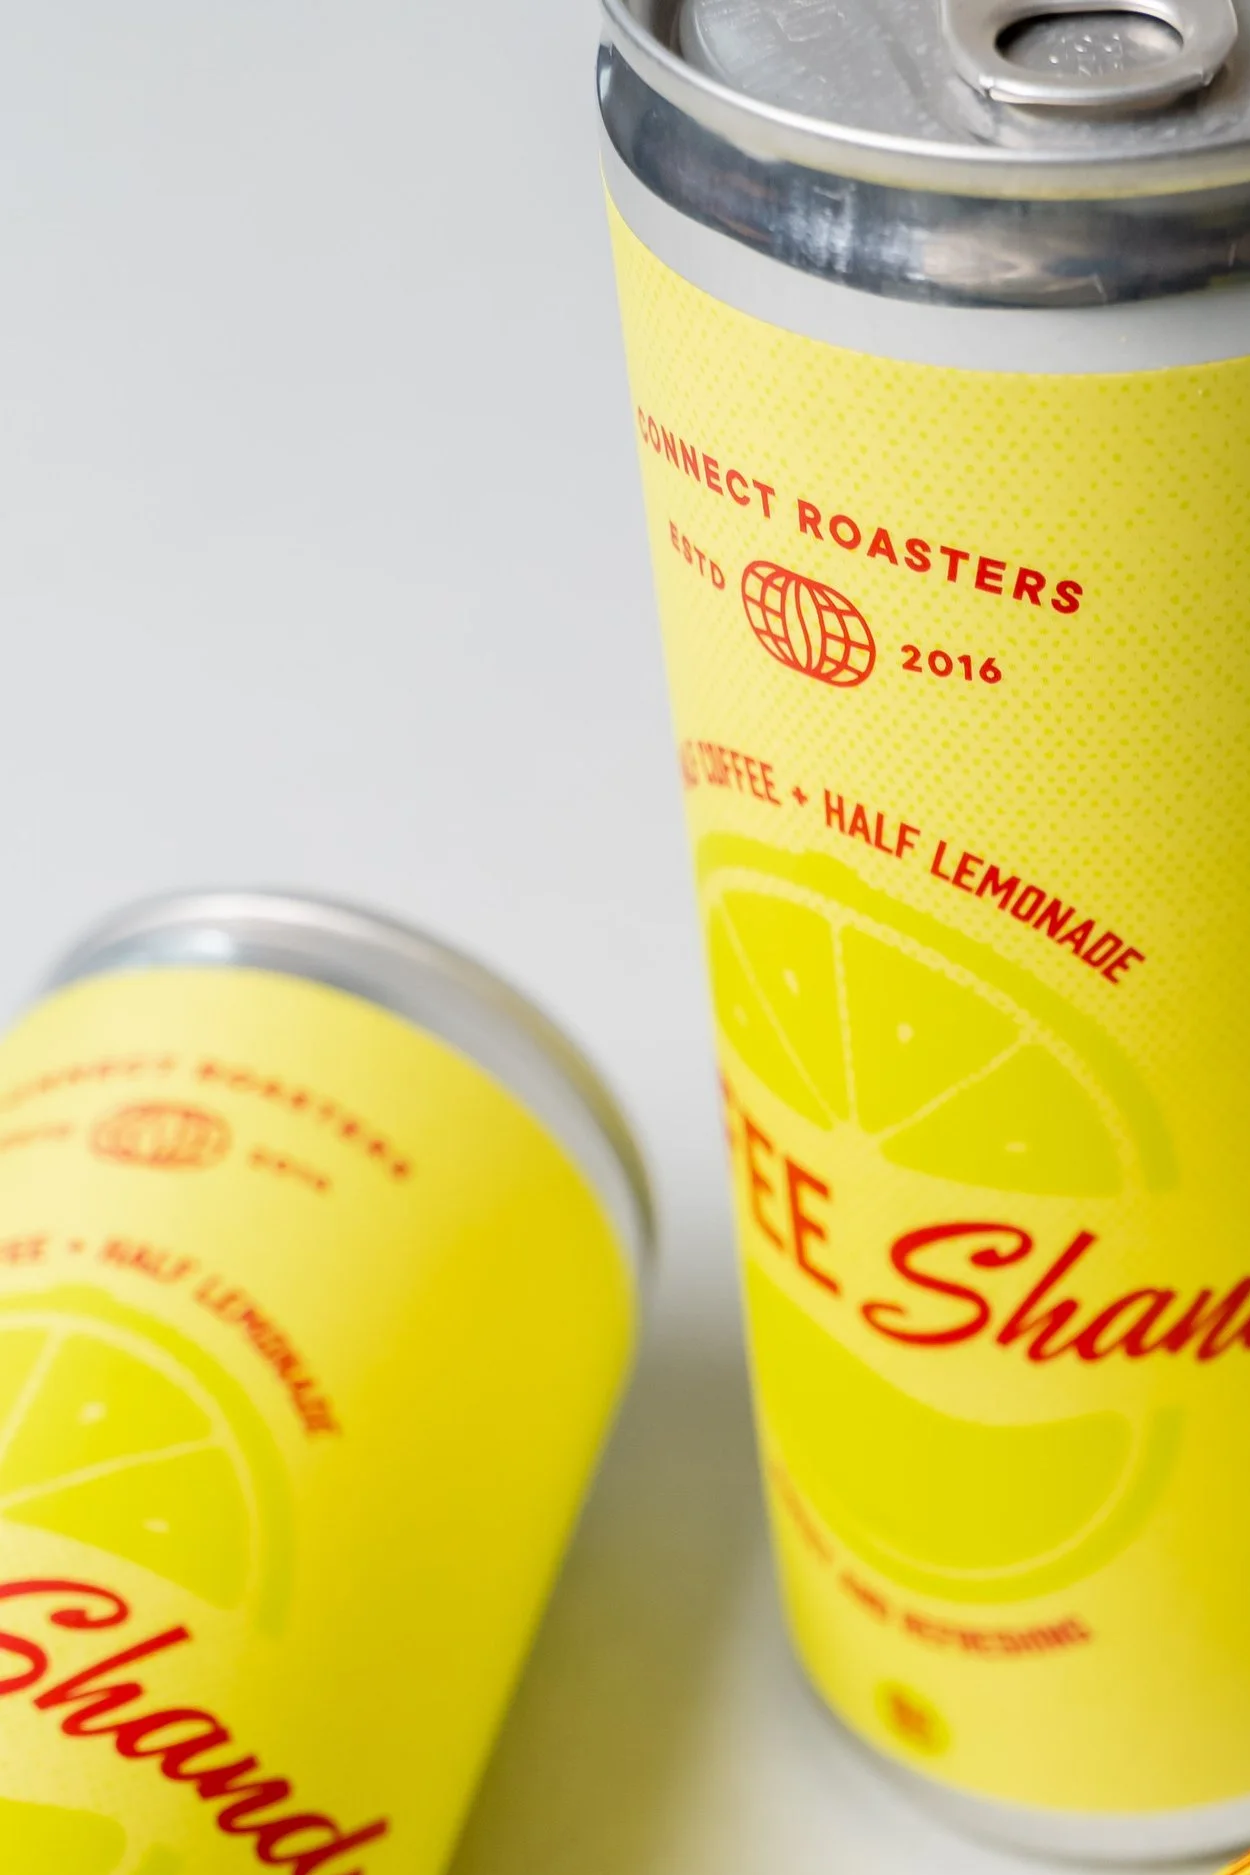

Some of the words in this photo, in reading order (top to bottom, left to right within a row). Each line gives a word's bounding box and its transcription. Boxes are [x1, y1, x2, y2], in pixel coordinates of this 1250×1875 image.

[637, 405, 777, 520] CONNECT
[796, 498, 1085, 616] ROASTERS
[668, 518, 727, 591] ESTD
[900, 643, 1003, 686] 2016
[822, 788, 922, 859] HALF
[929, 838, 1147, 987] LEMONADE
